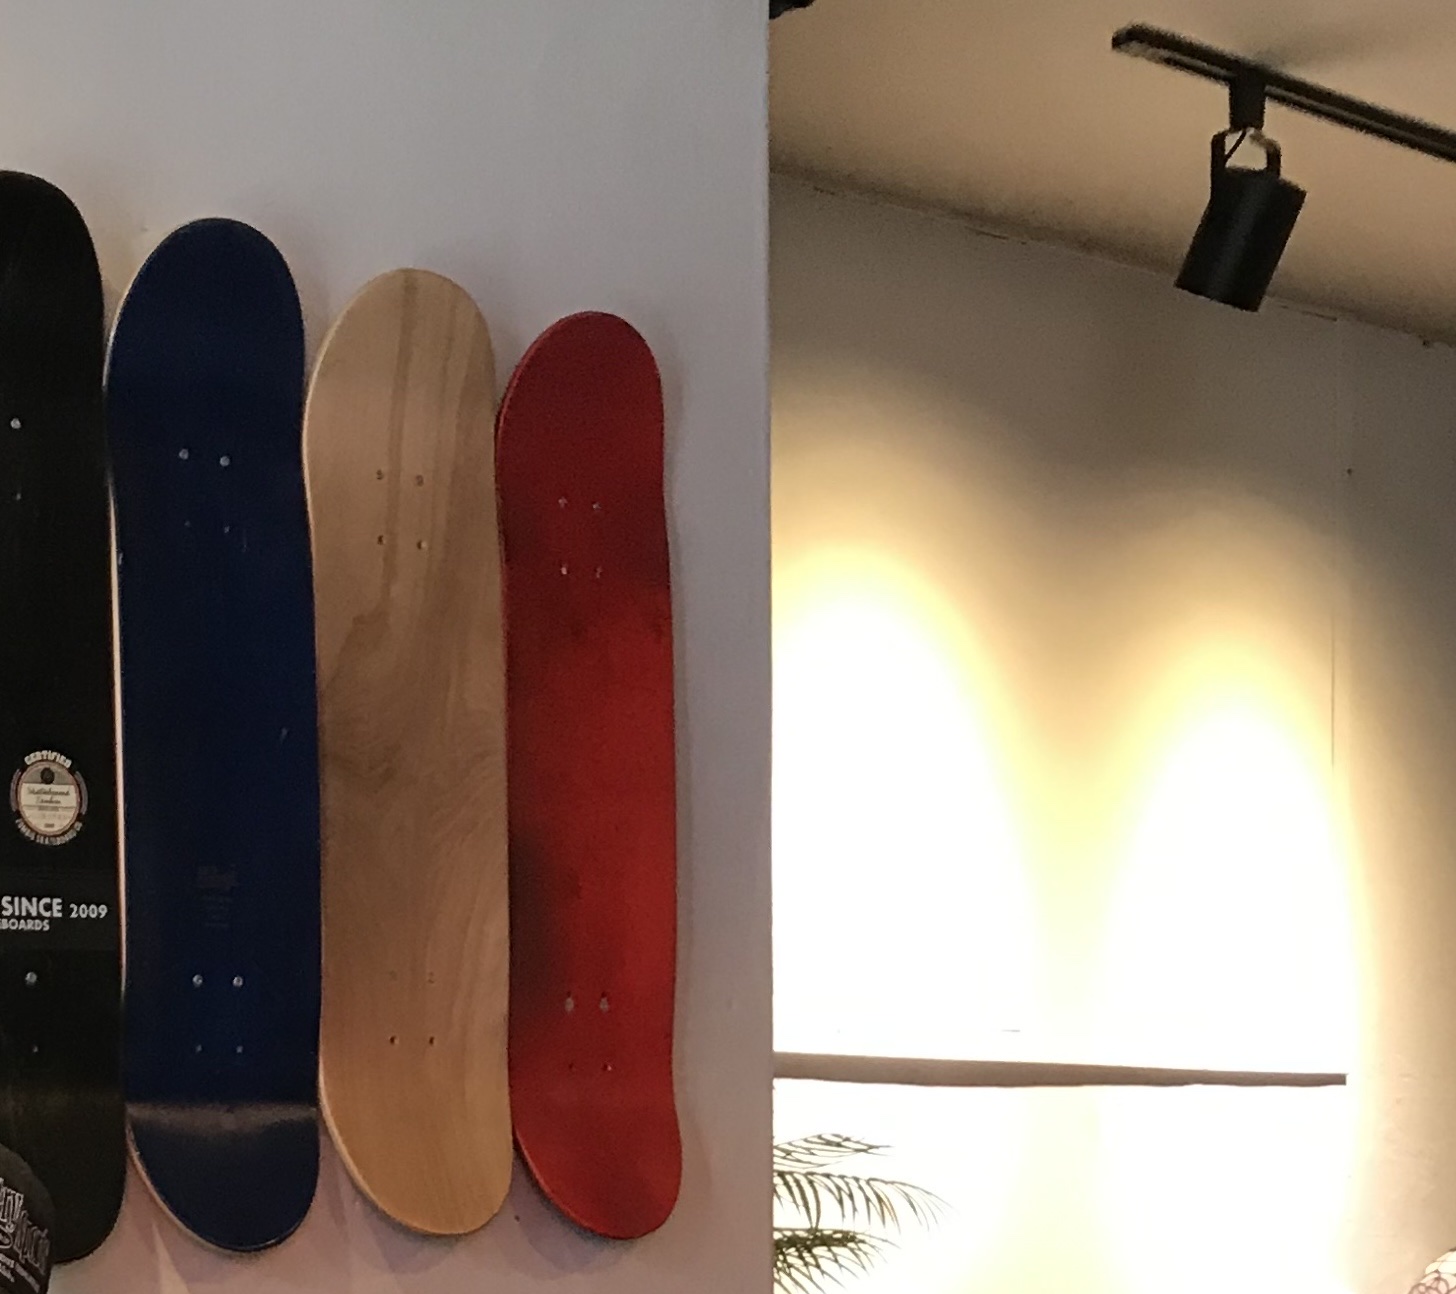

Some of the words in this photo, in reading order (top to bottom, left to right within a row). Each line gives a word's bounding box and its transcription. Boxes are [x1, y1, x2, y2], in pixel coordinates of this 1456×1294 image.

[24, 749, 72, 769] CERTIFIED
[1, 896, 63, 918] SINCE
[69, 903, 109, 919] 2009
